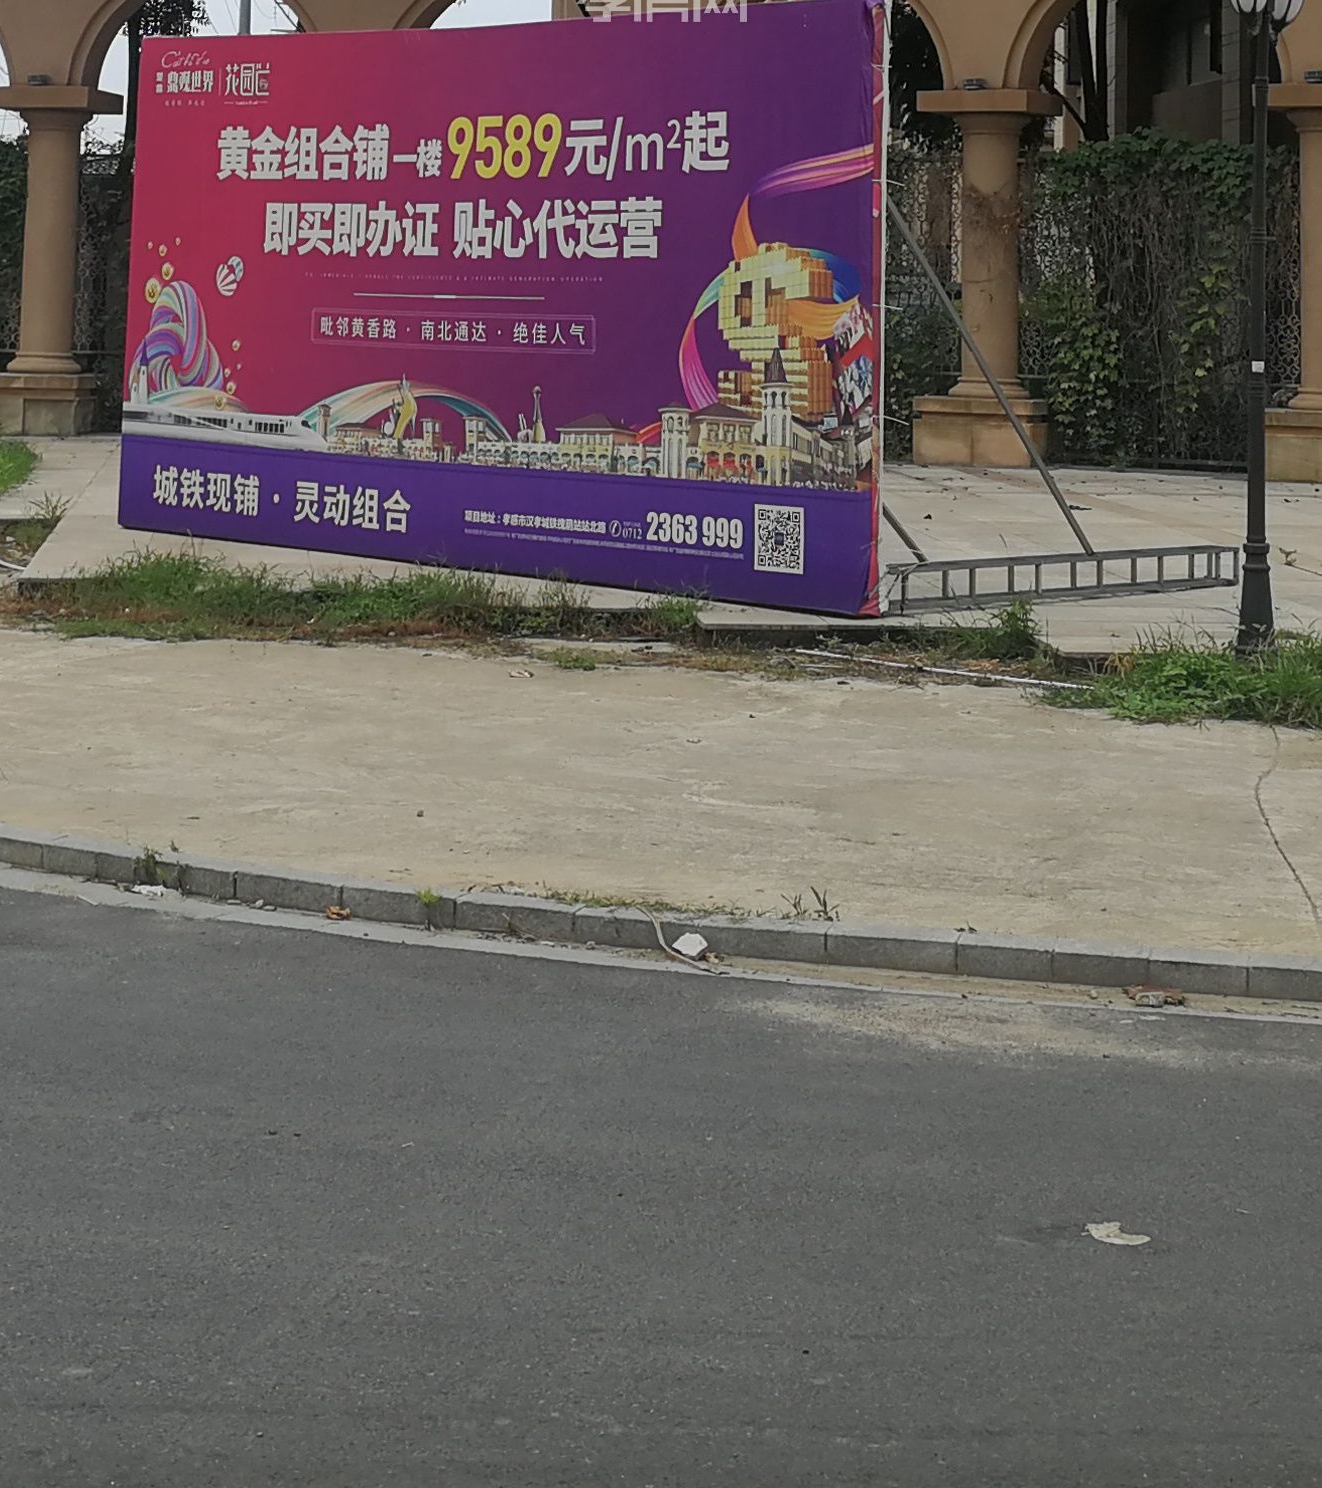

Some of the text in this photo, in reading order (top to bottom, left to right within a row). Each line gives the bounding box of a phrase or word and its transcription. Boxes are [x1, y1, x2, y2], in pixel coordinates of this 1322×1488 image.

[263, 196, 663, 259] 即买即办证 贴心代运营
[622, 526, 643, 540] 0712
[646, 511, 698, 545] 2363
[701, 516, 744, 549] 999
